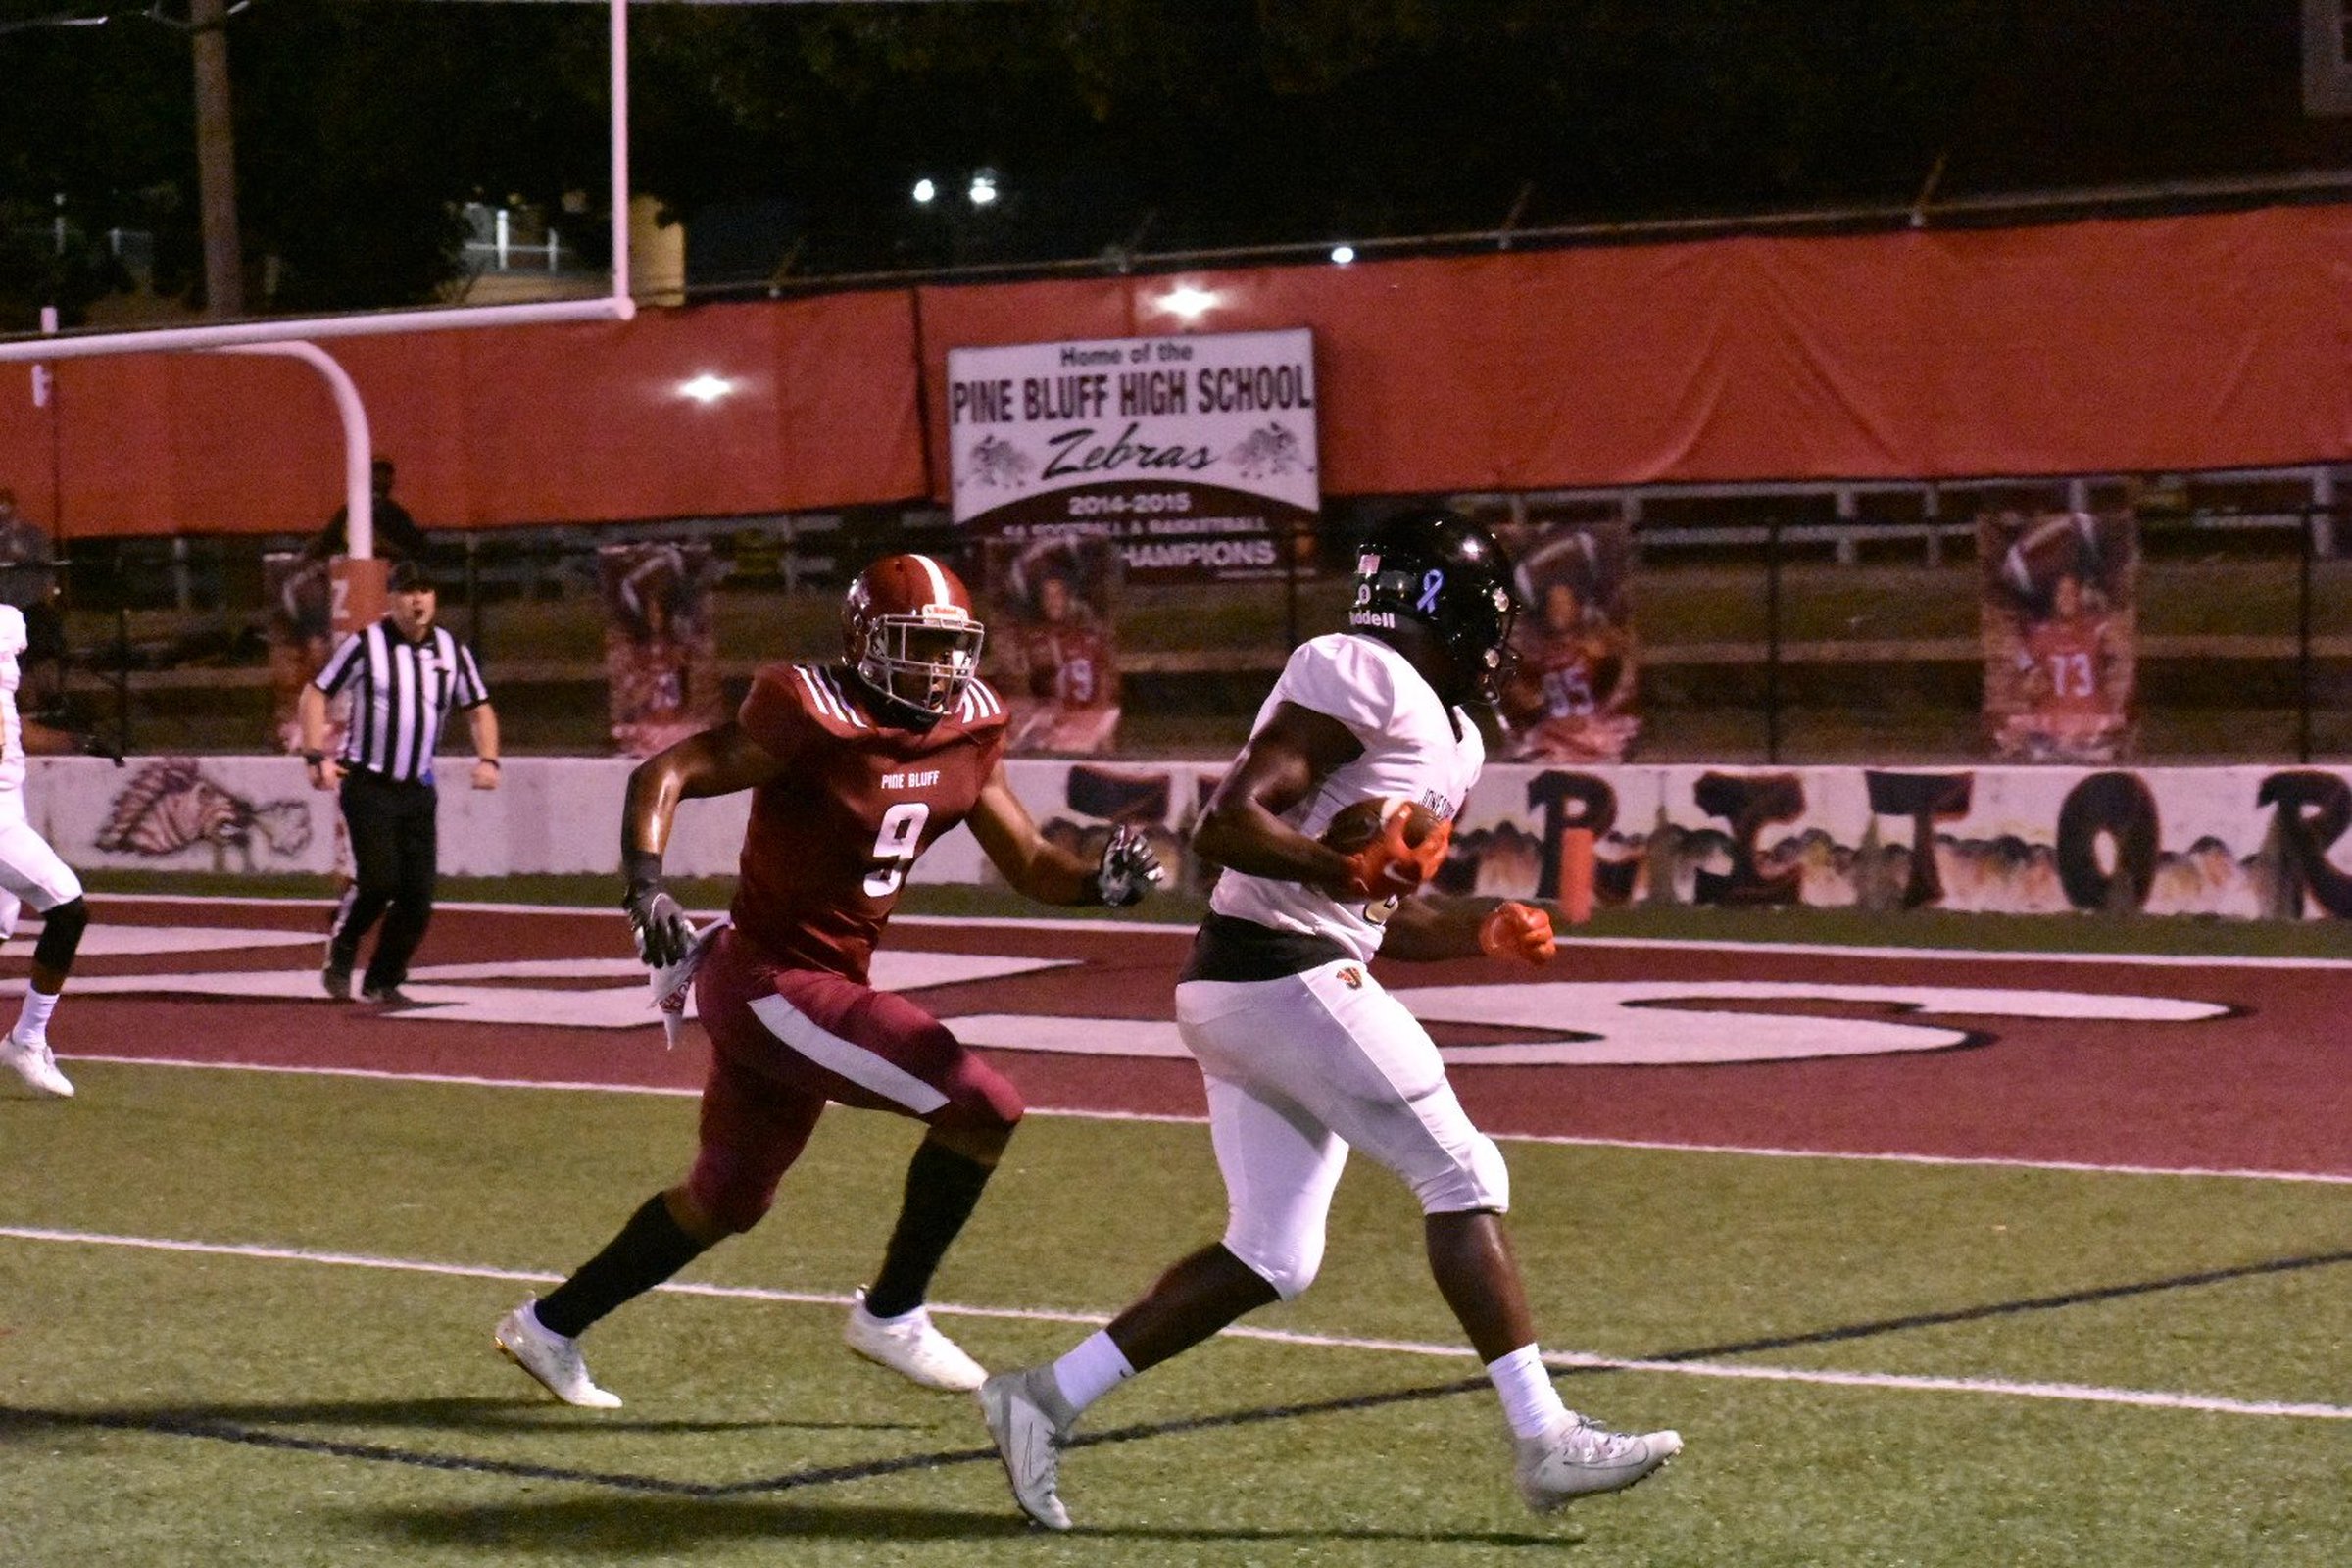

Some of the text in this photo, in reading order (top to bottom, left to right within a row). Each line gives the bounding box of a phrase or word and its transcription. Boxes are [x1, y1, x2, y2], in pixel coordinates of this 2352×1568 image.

[1060, 342, 1193, 367] Home of the
[952, 365, 1312, 424] PINE BLUFF HIGH SCHOOL
[1041, 422, 1220, 480] Zebras
[1069, 492, 1192, 514] 2014-2015
[1123, 540, 1276, 567] HAMPIONS
[881, 770, 940, 789] PINE BLUFF
[863, 802, 930, 897] 9
